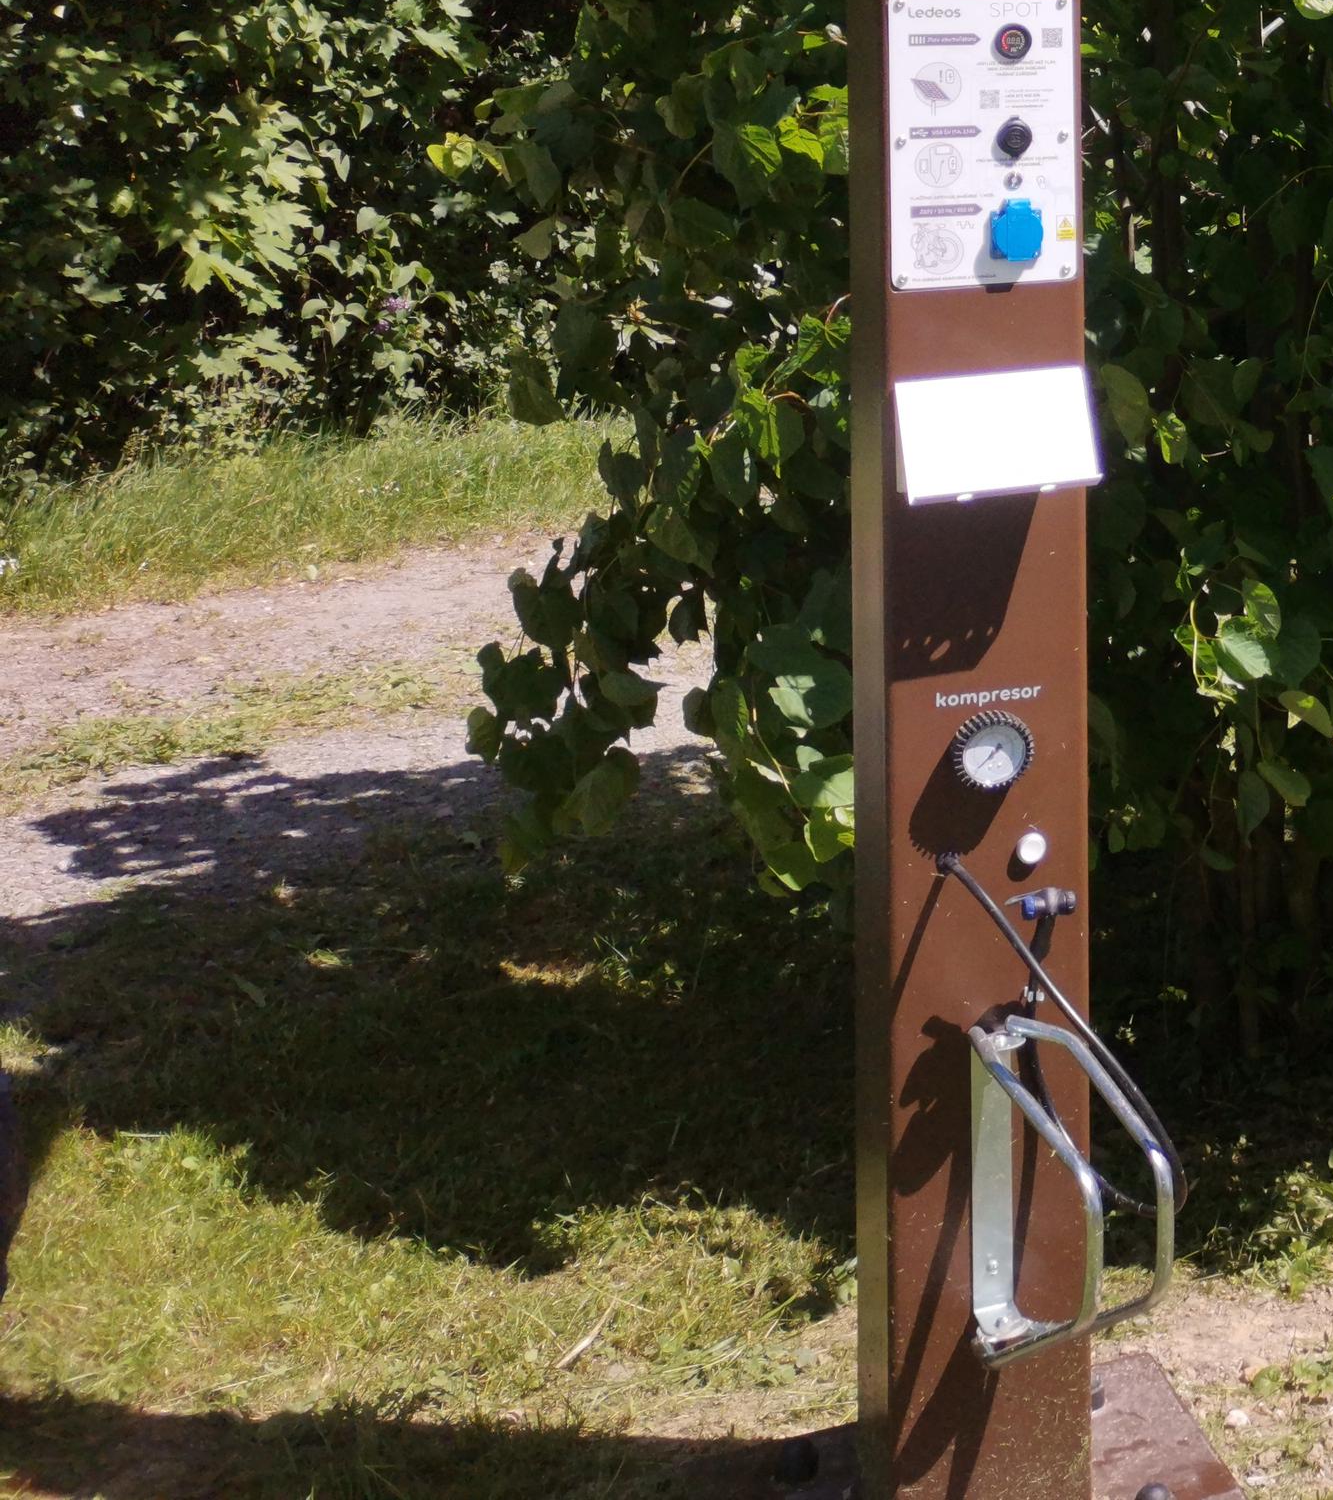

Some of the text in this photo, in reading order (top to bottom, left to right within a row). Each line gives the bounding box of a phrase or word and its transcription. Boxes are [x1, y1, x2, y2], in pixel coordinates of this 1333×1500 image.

[907, 6, 961, 19] Ledeos
[990, 2, 1042, 18] SPOT
[935, 684, 1042, 708] kompresor
